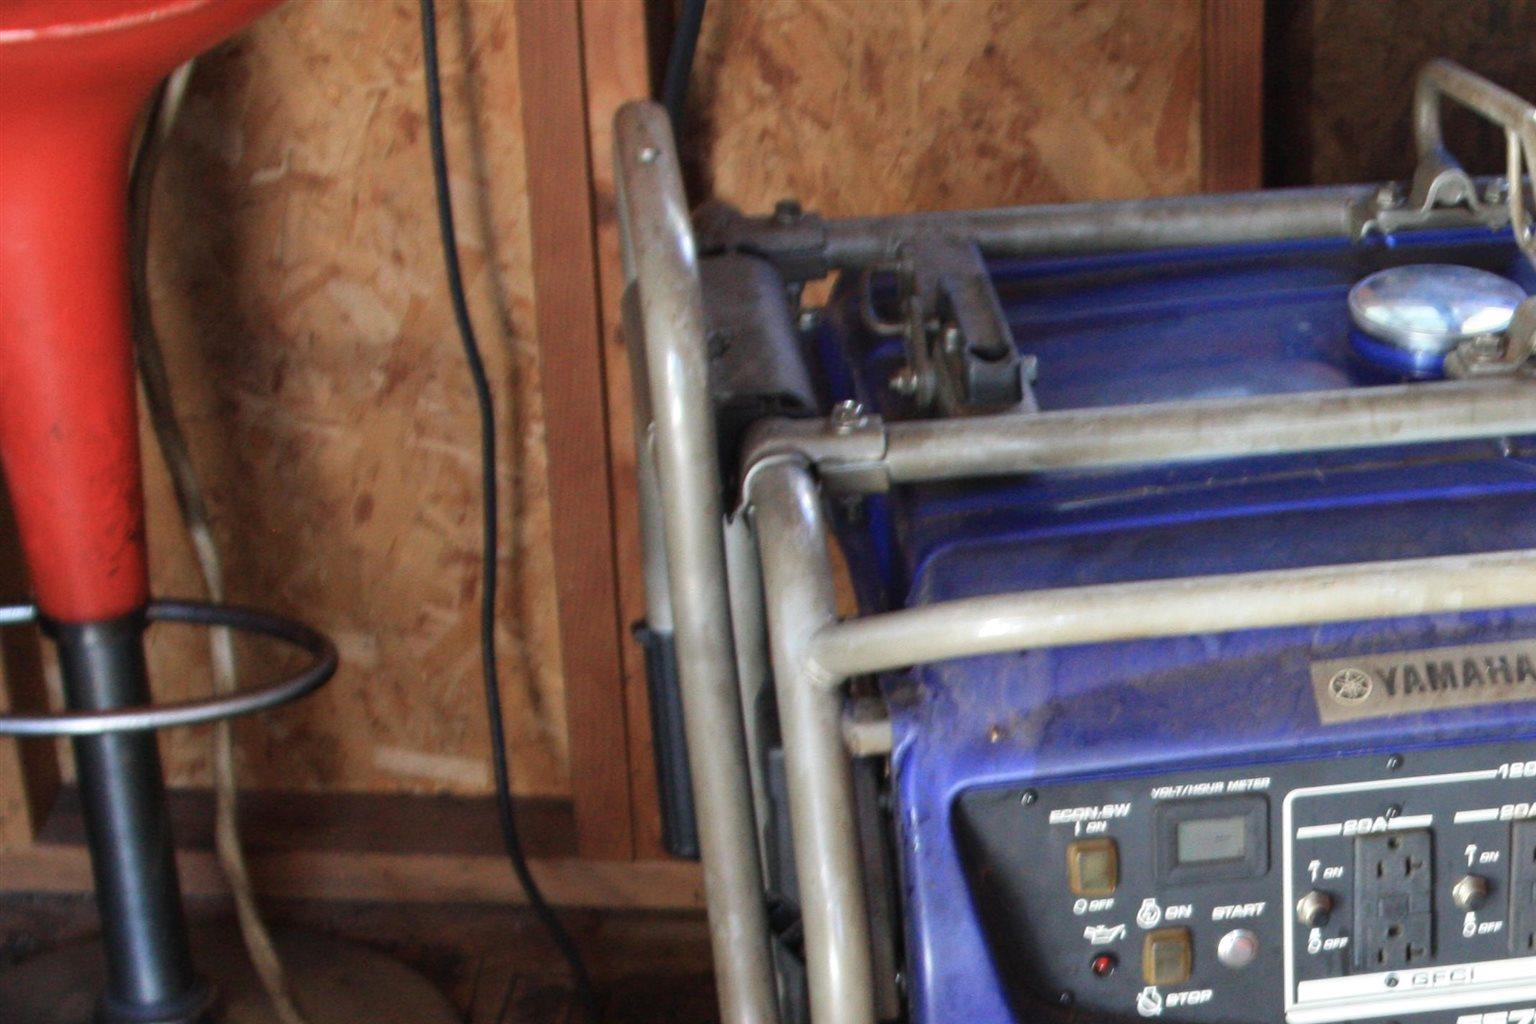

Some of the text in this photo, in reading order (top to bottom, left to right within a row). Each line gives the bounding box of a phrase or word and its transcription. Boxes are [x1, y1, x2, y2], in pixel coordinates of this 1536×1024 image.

[1227, 777, 1271, 793] METER
[1164, 904, 1194, 920] ON
[1211, 901, 1267, 921] START
[1411, 968, 1476, 987] GFCI
[1165, 989, 1214, 1008] STOP
